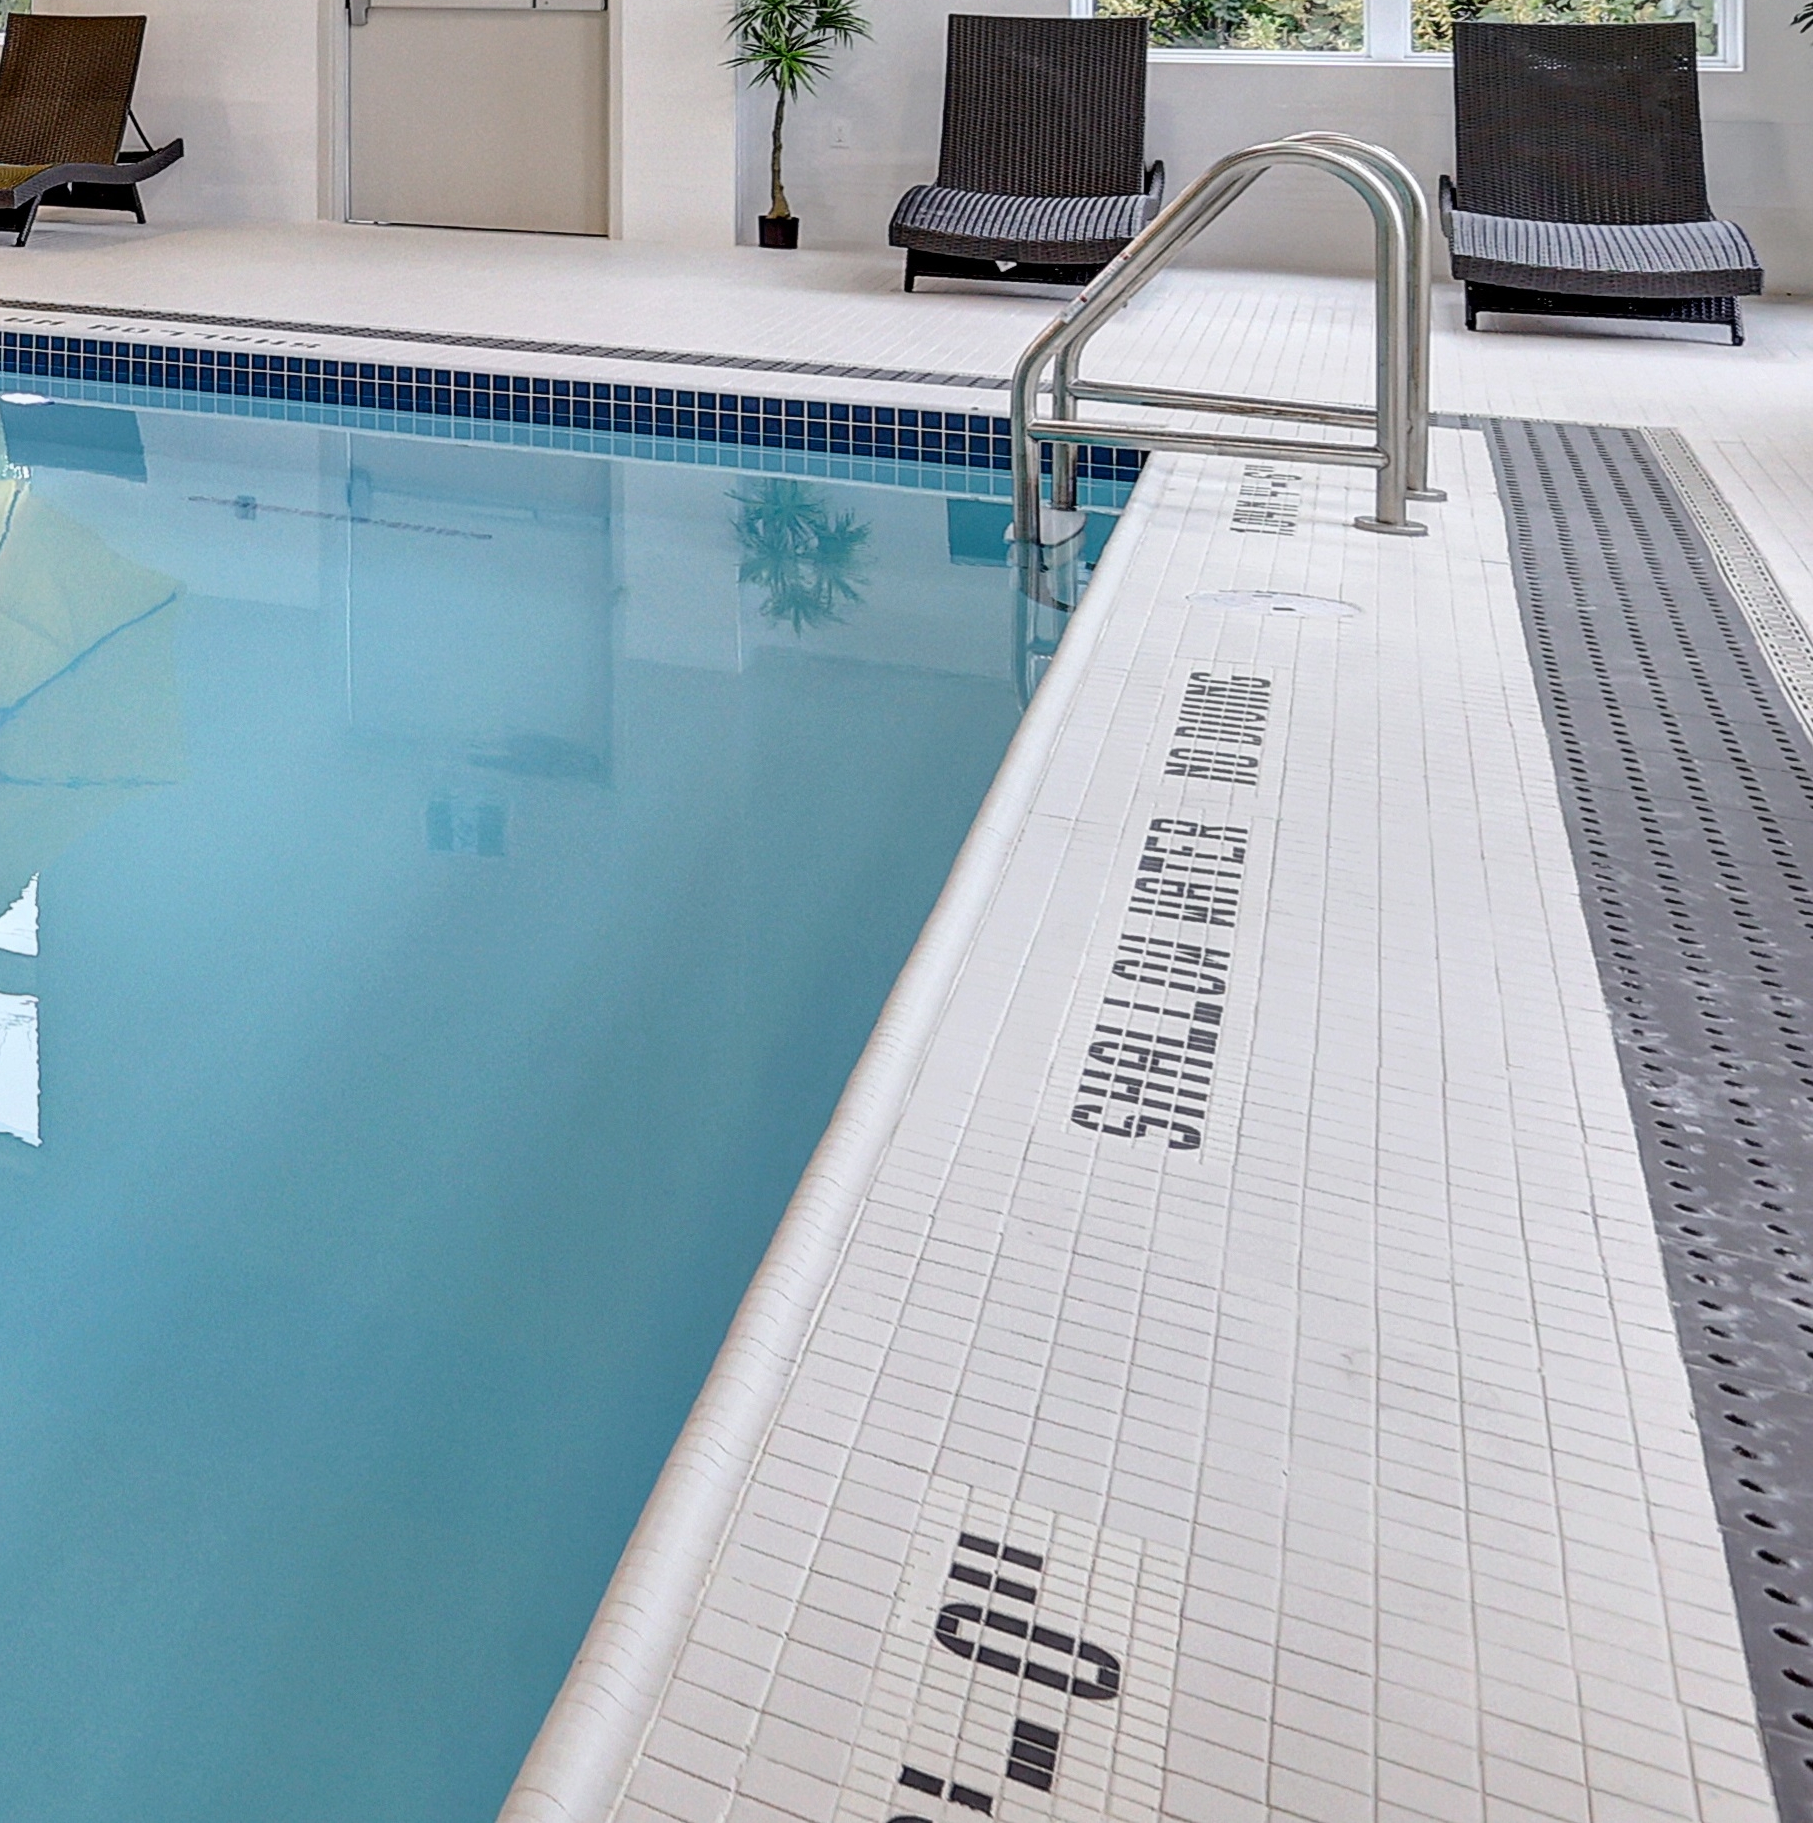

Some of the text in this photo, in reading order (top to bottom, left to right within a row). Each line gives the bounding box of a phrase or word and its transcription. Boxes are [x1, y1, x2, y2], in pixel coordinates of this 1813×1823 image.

[85, 323, 321, 349] SHALLOW
[1164, 672, 1272, 786] NO DIVING
[1070, 818, 1249, 1151] SHALLOW WATER
